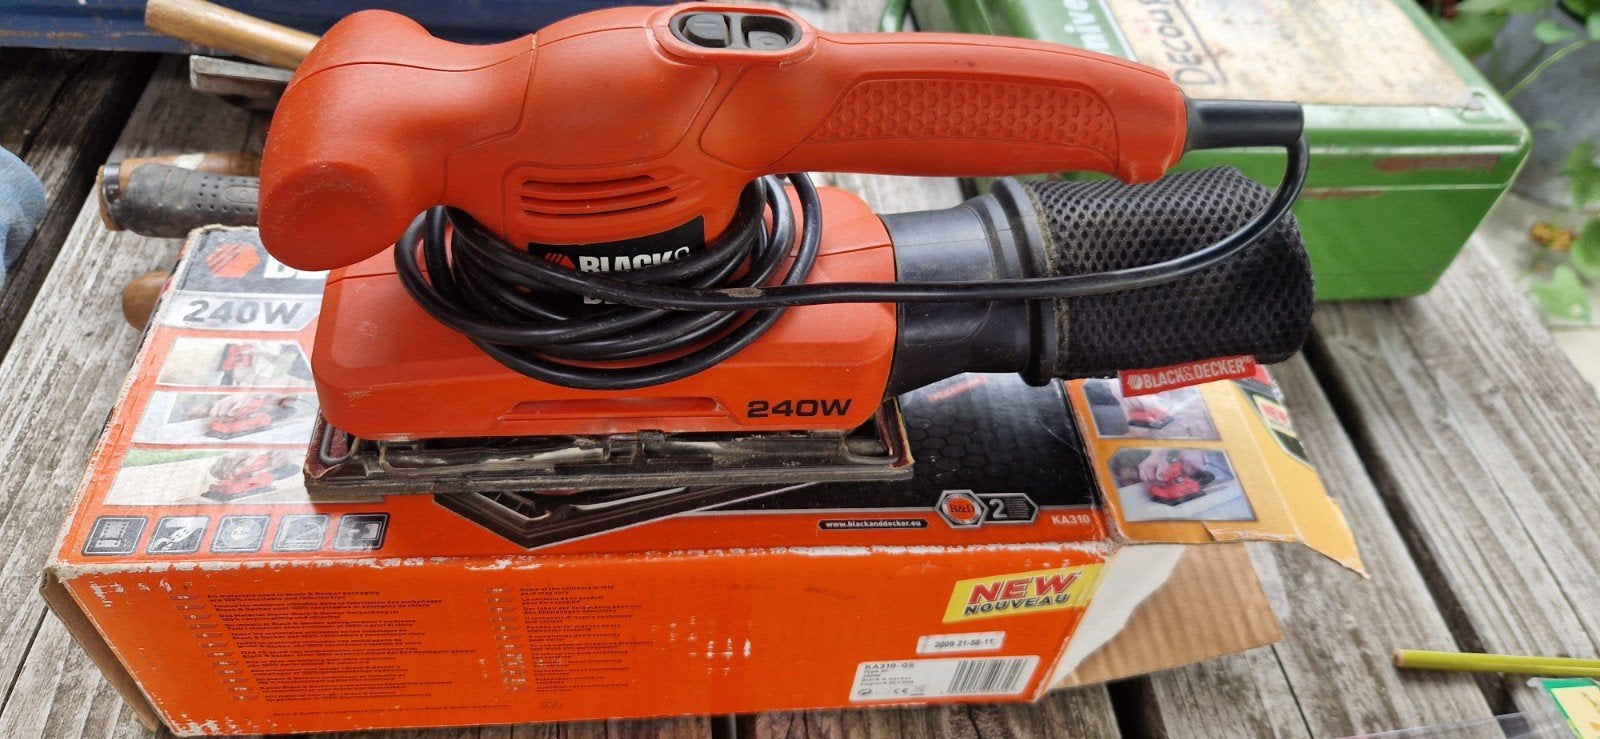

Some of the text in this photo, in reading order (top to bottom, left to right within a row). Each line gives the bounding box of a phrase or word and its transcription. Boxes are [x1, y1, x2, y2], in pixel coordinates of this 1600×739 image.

[182, 300, 302, 325] 240W
[747, 399, 852, 418] 240W
[989, 498, 1008, 519] 2
[825, 520, 922, 528] www.blackanddecker.eu
[1051, 514, 1091, 525] KA310
[968, 573, 1078, 605] NEW
[964, 594, 1071, 616] NOUVEAU
